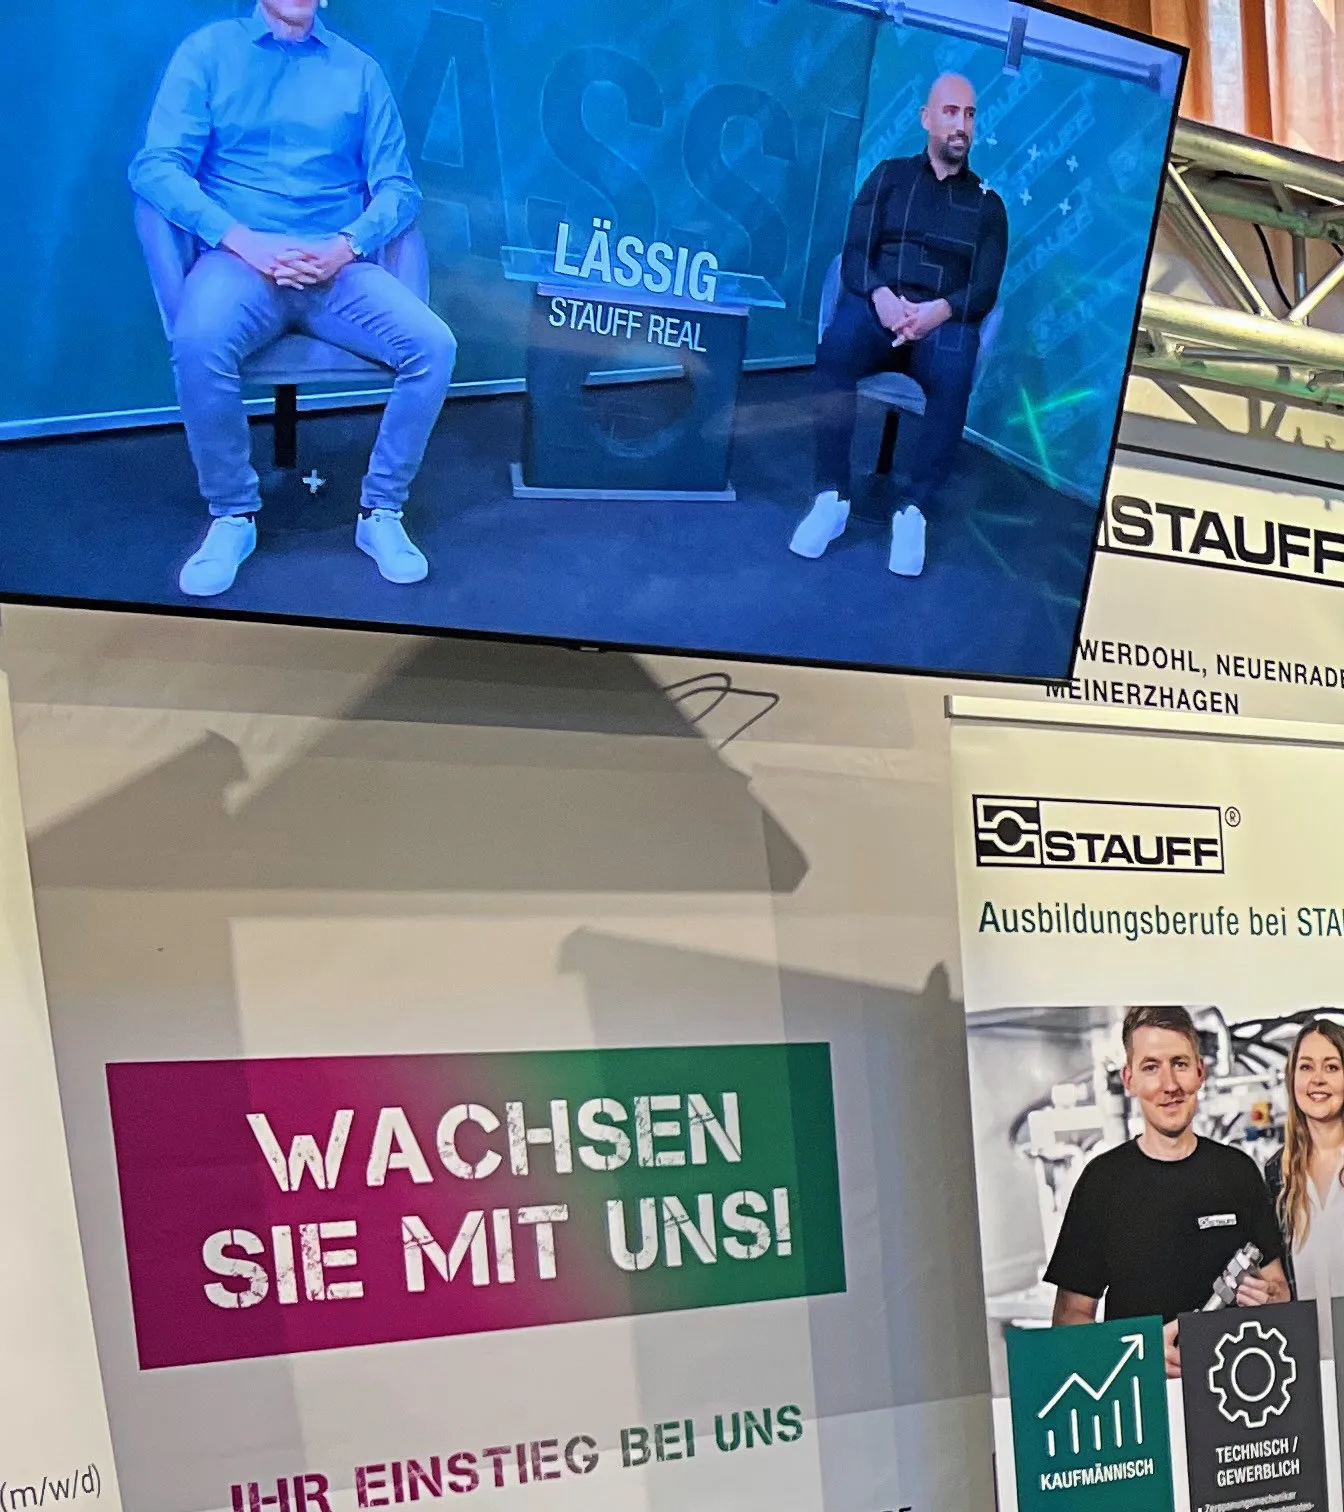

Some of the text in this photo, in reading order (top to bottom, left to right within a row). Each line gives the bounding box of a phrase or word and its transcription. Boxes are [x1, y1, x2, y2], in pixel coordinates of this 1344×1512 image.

[553, 217, 719, 302] LÄSSIG
[549, 296, 707, 352] STAUFF REAL
[1079, 639, 1208, 678] WERDOHL,
[1046, 679, 1240, 715] MEINERZHAGEN
[1045, 831, 1219, 867] STAUFF
[978, 901, 1240, 941] Ausbildungsberufe
[1249, 906, 1287, 937] bei
[246, 1091, 742, 1193] WACHSEN
[203, 1187, 793, 1310] SIE MIT UNS!
[354, 1434, 600, 1510] EINSTIEG
[620, 1417, 697, 1468] BEI
[713, 1404, 805, 1453] UNS
[1216, 1437, 1289, 1464] TECHNISCH
[1040, 1458, 1154, 1491] KAUFMÄNNISCH
[1217, 1459, 1300, 1487] GEWERBLICH
